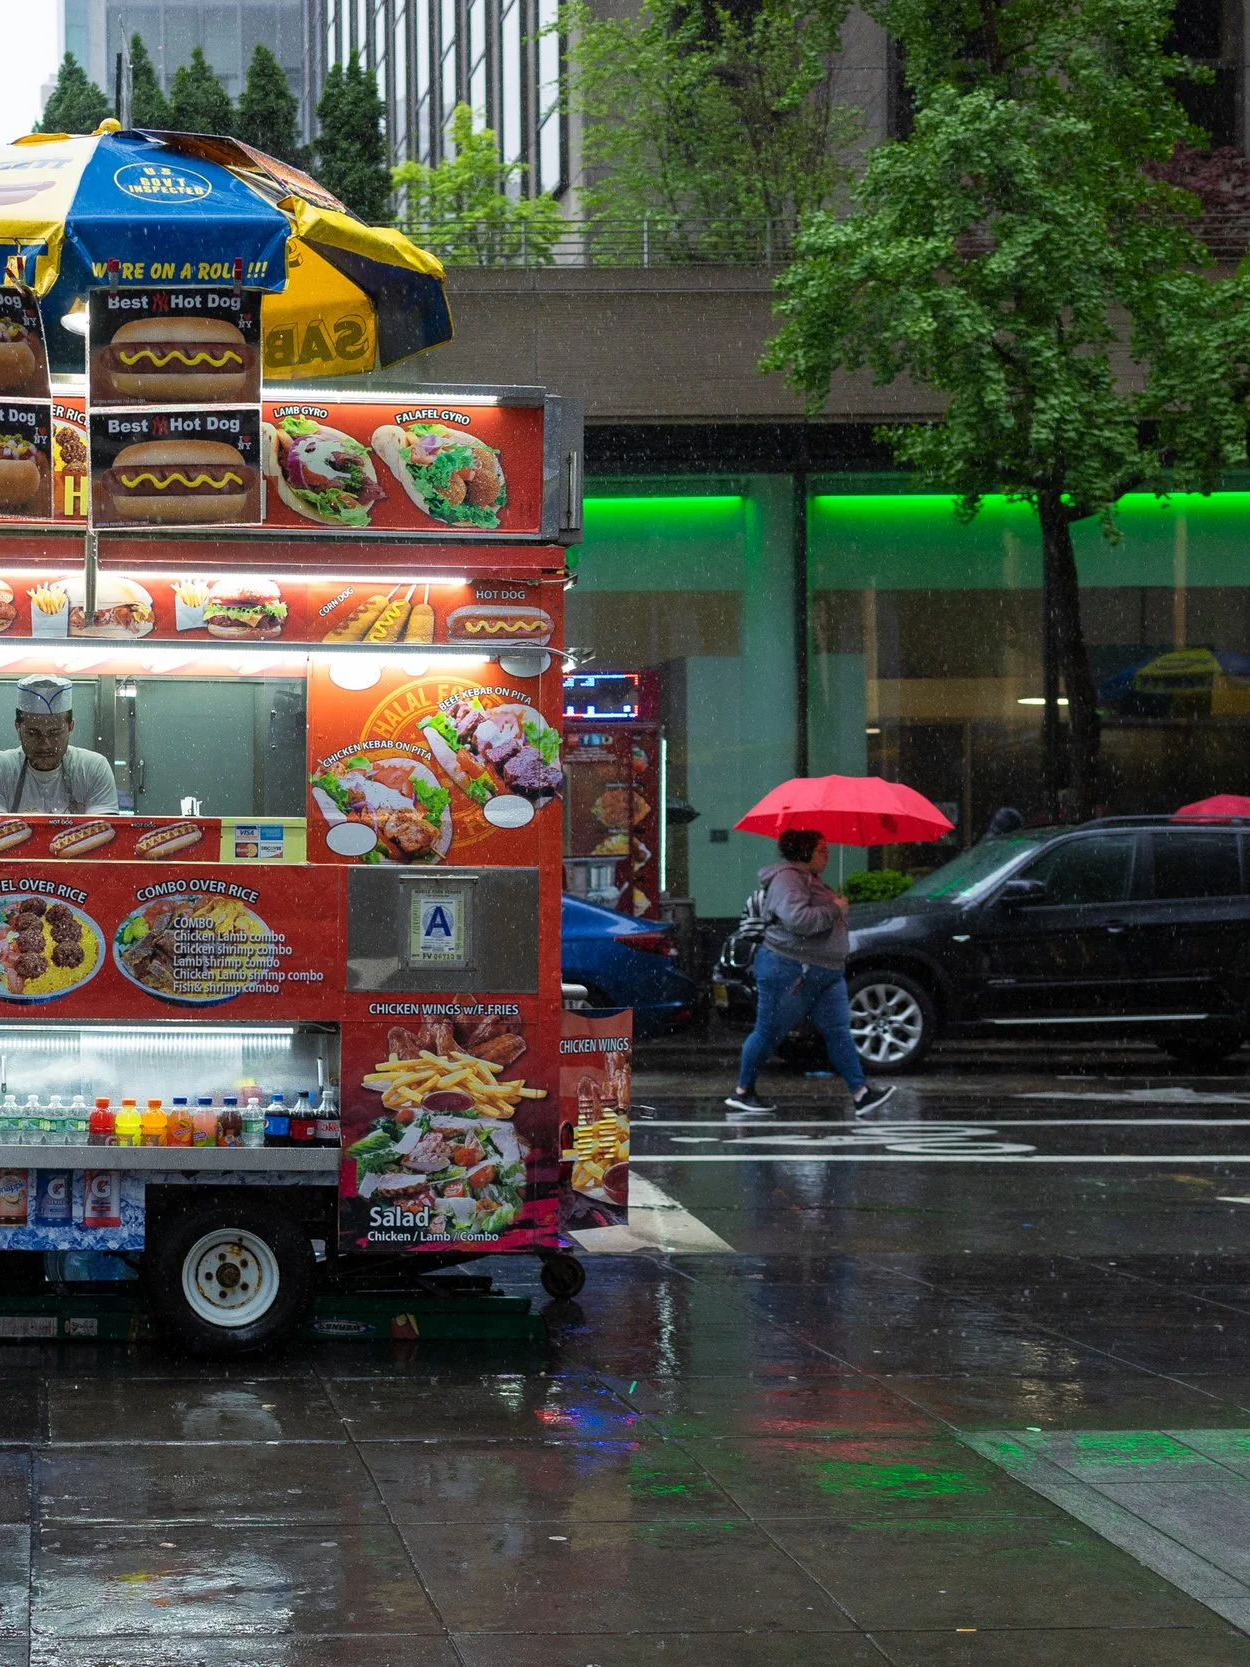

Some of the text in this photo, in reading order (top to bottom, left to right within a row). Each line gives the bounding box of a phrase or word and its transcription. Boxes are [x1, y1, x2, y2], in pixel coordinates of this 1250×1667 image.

[143, 167, 173, 176] U.S.
[128, 185, 204, 195] INSPECTED
[150, 262, 174, 279] ON
[180, 262, 192, 279] A
[107, 294, 242, 311] Best Hot Dog
[8, 407, 36, 427] Dog
[273, 406, 328, 419] LAMB GYRO
[395, 409, 470, 425] FALAFEL GYRO
[108, 416, 241, 434] Best Hot Dog
[318, 587, 355, 617] CORN DOG
[475, 590, 526, 600] HOT DOG
[438, 686, 533, 711] BEEF KEBAB ON PITA
[372, 687, 428, 739] HALAL
[322, 739, 432, 768] CHICKEN KEBAB ON PITA
[19, 879, 54, 893] OVER
[55, 883, 88, 904] RICE
[136, 879, 261, 903] COMBO OVER RICE
[173, 917, 214, 930] COMBO
[424, 906, 452, 937] A
[173, 930, 285, 942] Chicken Lamb combo
[173, 943, 292, 957] Chicken shrimp combo
[173, 956, 280, 970] Lamb shrimp combo
[173, 969, 324, 983] Chicken Lamb shrimp combo
[173, 982, 279, 995] Fish& shrimp combo
[368, 1003, 519, 1016] CHICKEN WINGS w/F.FRIES
[559, 1037, 629, 1054] CHICKEN WINGS
[369, 1206, 430, 1228] Salad
[367, 1231, 411, 1242] Chicken
[413, 1231, 418, 1242] /
[420, 1231, 451, 1242] Lamb
[459, 1231, 499, 1242] Combo
